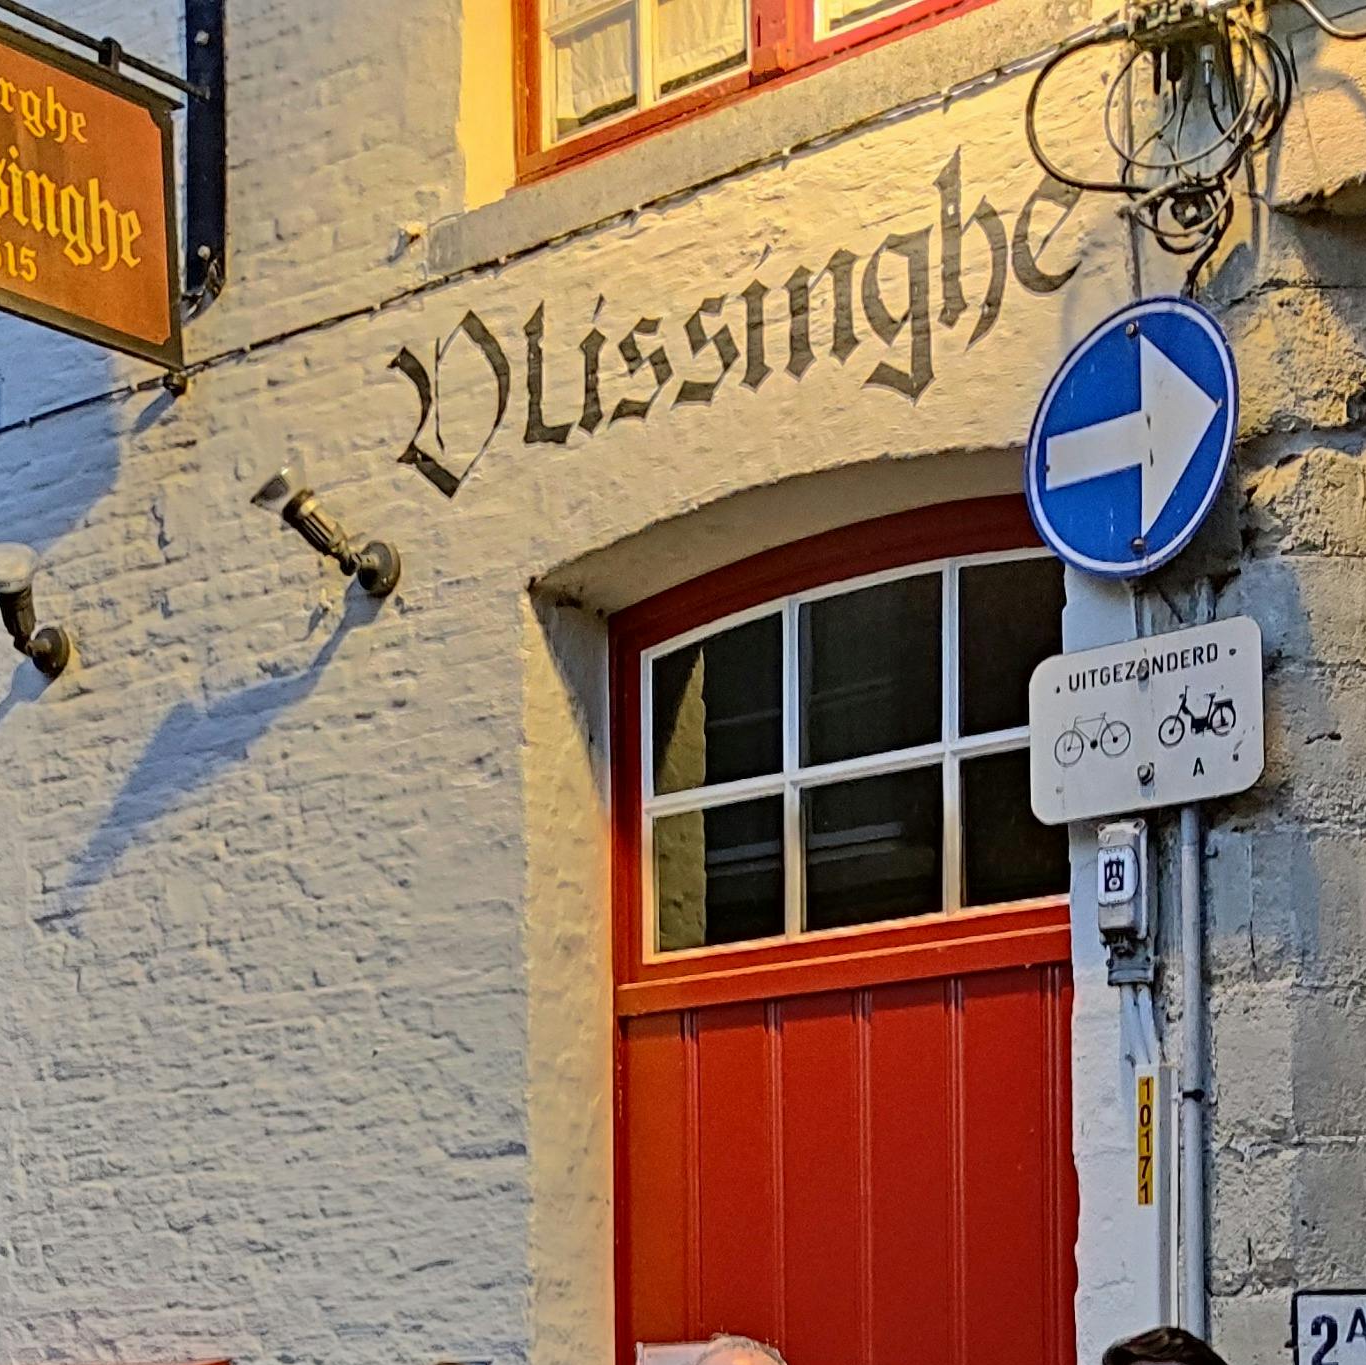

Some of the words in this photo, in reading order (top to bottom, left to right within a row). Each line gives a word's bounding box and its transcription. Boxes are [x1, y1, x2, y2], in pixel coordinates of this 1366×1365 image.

[386, 145, 1084, 499] Vlissinghe
[1068, 643, 1218, 692] UITGEZONDERD
[1192, 757, 1205, 777] A
[1140, 1077, 1152, 1204] 10171
